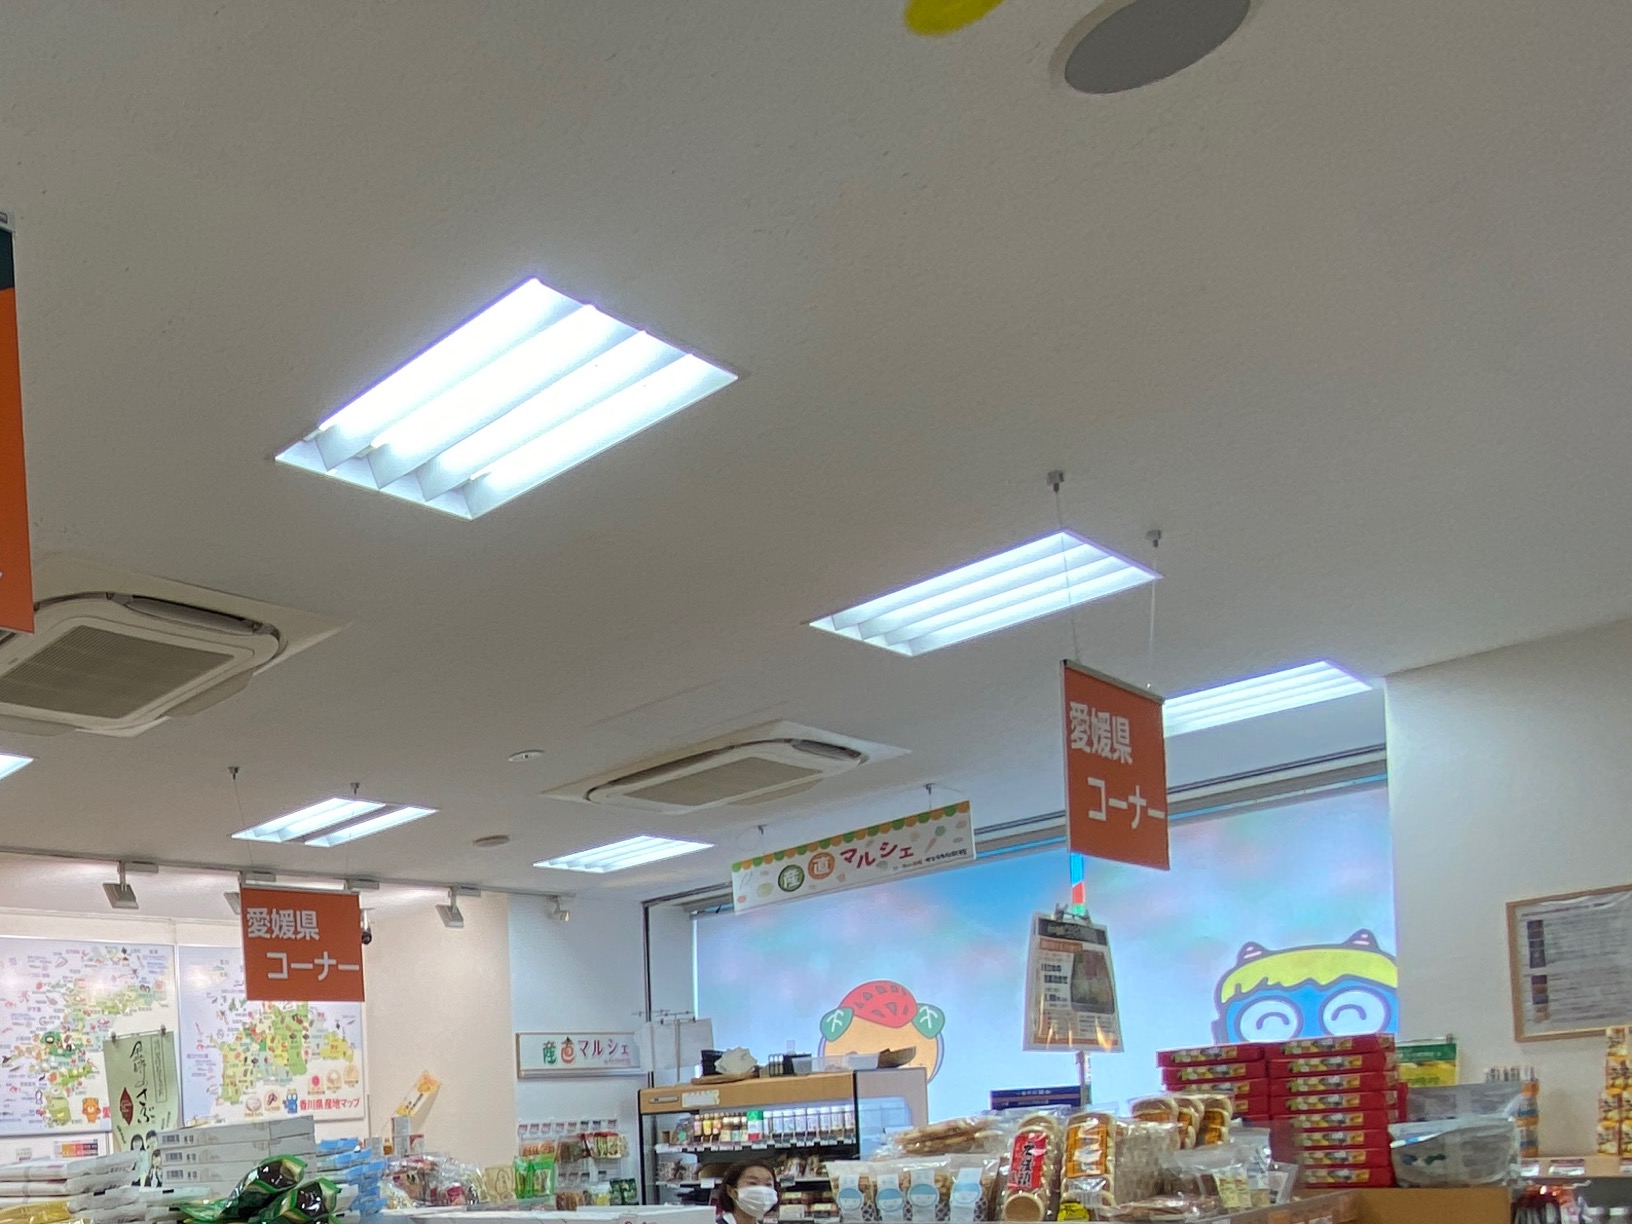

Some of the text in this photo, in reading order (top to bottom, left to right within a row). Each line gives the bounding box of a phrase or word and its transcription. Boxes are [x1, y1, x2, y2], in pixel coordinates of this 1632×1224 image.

[1069, 702, 1133, 764] 愛媛県
[1087, 777, 1164, 829] コーナー
[246, 908, 319, 941] 愛媛県
[267, 952, 360, 981] コーナー
